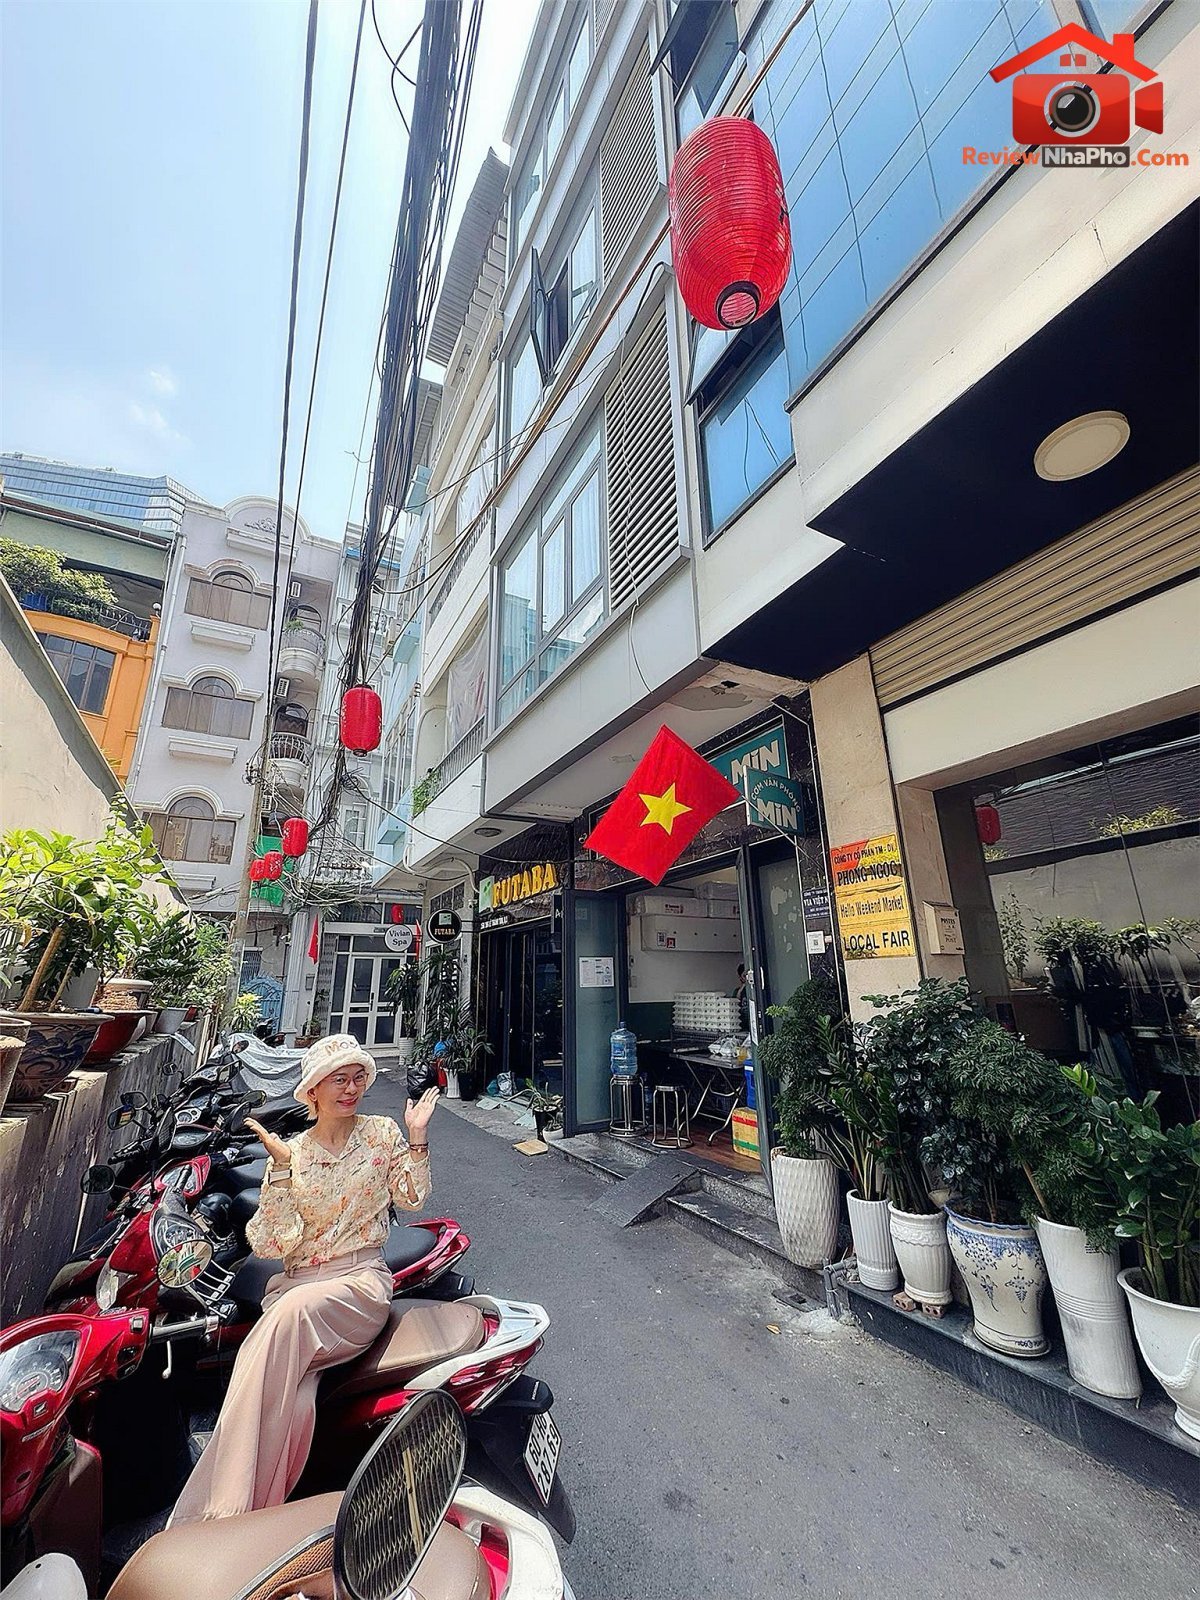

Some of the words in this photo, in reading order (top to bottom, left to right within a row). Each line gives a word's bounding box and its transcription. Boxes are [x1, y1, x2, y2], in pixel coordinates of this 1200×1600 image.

[492, 863, 558, 909] FUTABA
[840, 902, 855, 918] Hello
[855, 898, 882, 915] Weekend
[882, 895, 904, 912] Market
[392, 938, 407, 946] Spa
[843, 933, 880, 951] LOCAL
[882, 930, 910, 948] FAIR
